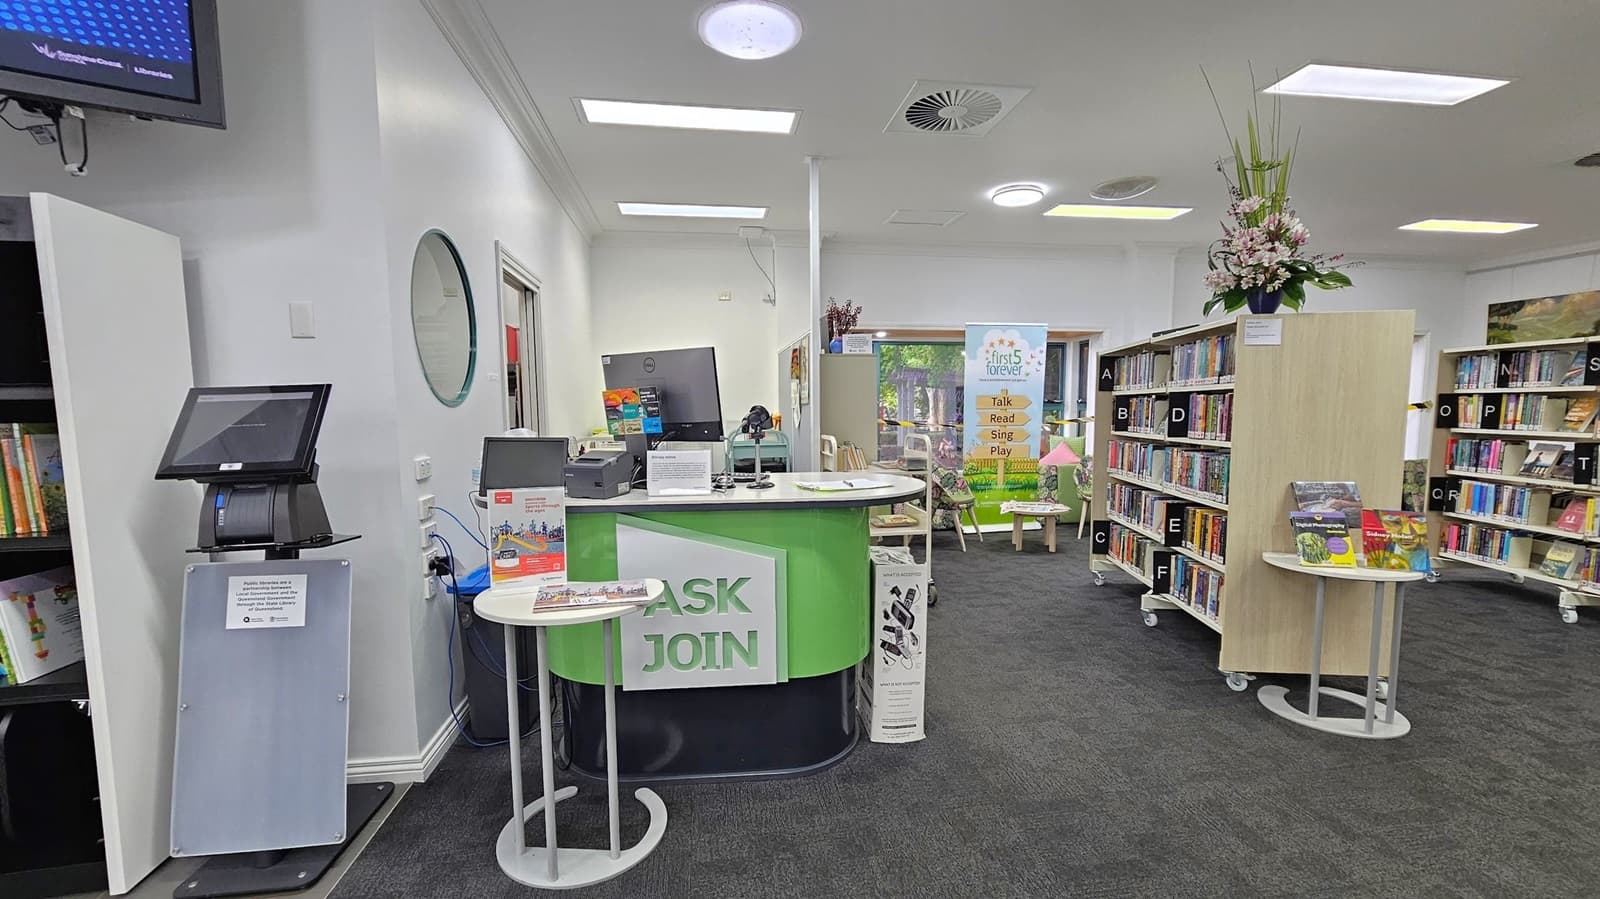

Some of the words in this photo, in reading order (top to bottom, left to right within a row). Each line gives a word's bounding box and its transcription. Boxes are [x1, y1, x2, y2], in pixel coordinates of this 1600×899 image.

[134, 66, 173, 79] Libraries
[986, 361, 1023, 376] forever
[1102, 368, 1112, 379] A
[991, 397, 1012, 407] Talk
[1118, 408, 1128, 419] B
[1172, 408, 1185, 422] D
[1440, 405, 1451, 417] O
[1484, 405, 1496, 417] P
[990, 414, 1015, 423] Read
[991, 430, 1014, 442] Sing
[990, 446, 1012, 458] Play
[1577, 457, 1591, 471] T
[1432, 488, 1444, 500] Q
[1448, 489, 1459, 501] R
[1169, 518, 1181, 533] E
[1095, 532, 1106, 543] C
[1366, 530, 1390, 539] Sidney
[1157, 566, 1168, 579] F
[643, 577, 752, 617] ASK
[642, 630, 759, 673] JOIN
